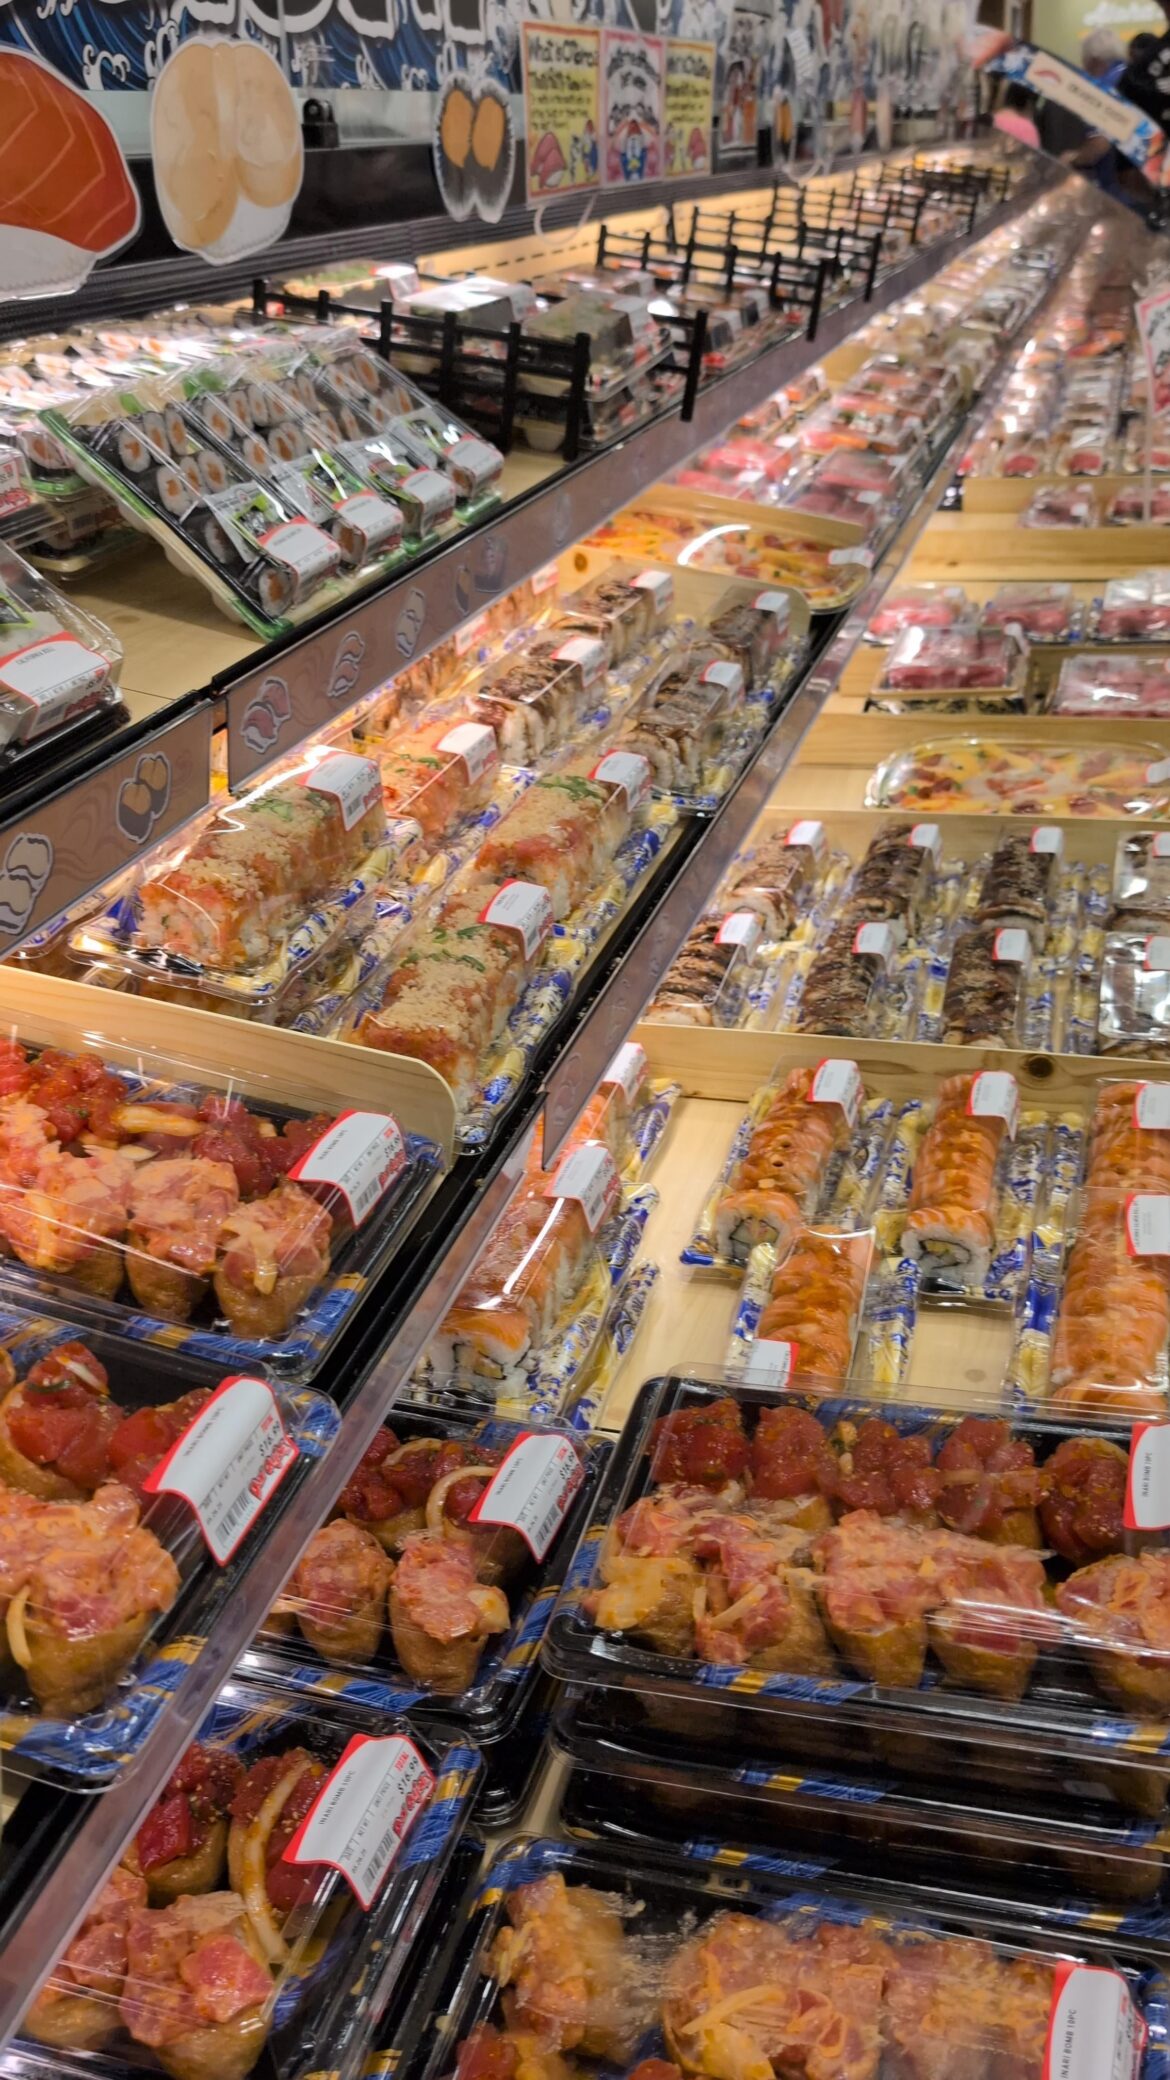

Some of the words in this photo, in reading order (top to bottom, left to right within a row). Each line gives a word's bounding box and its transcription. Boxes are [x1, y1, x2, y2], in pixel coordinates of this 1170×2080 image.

[395, 1752, 409, 1771] TOTAL
[398, 1756, 418, 1794] $16.99
[319, 1806, 333, 1824] INARI
[331, 1788, 345, 1806] BOMB
[1063, 2030, 1074, 2054] BOMB
[1061, 2055, 1071, 2079] INARI
